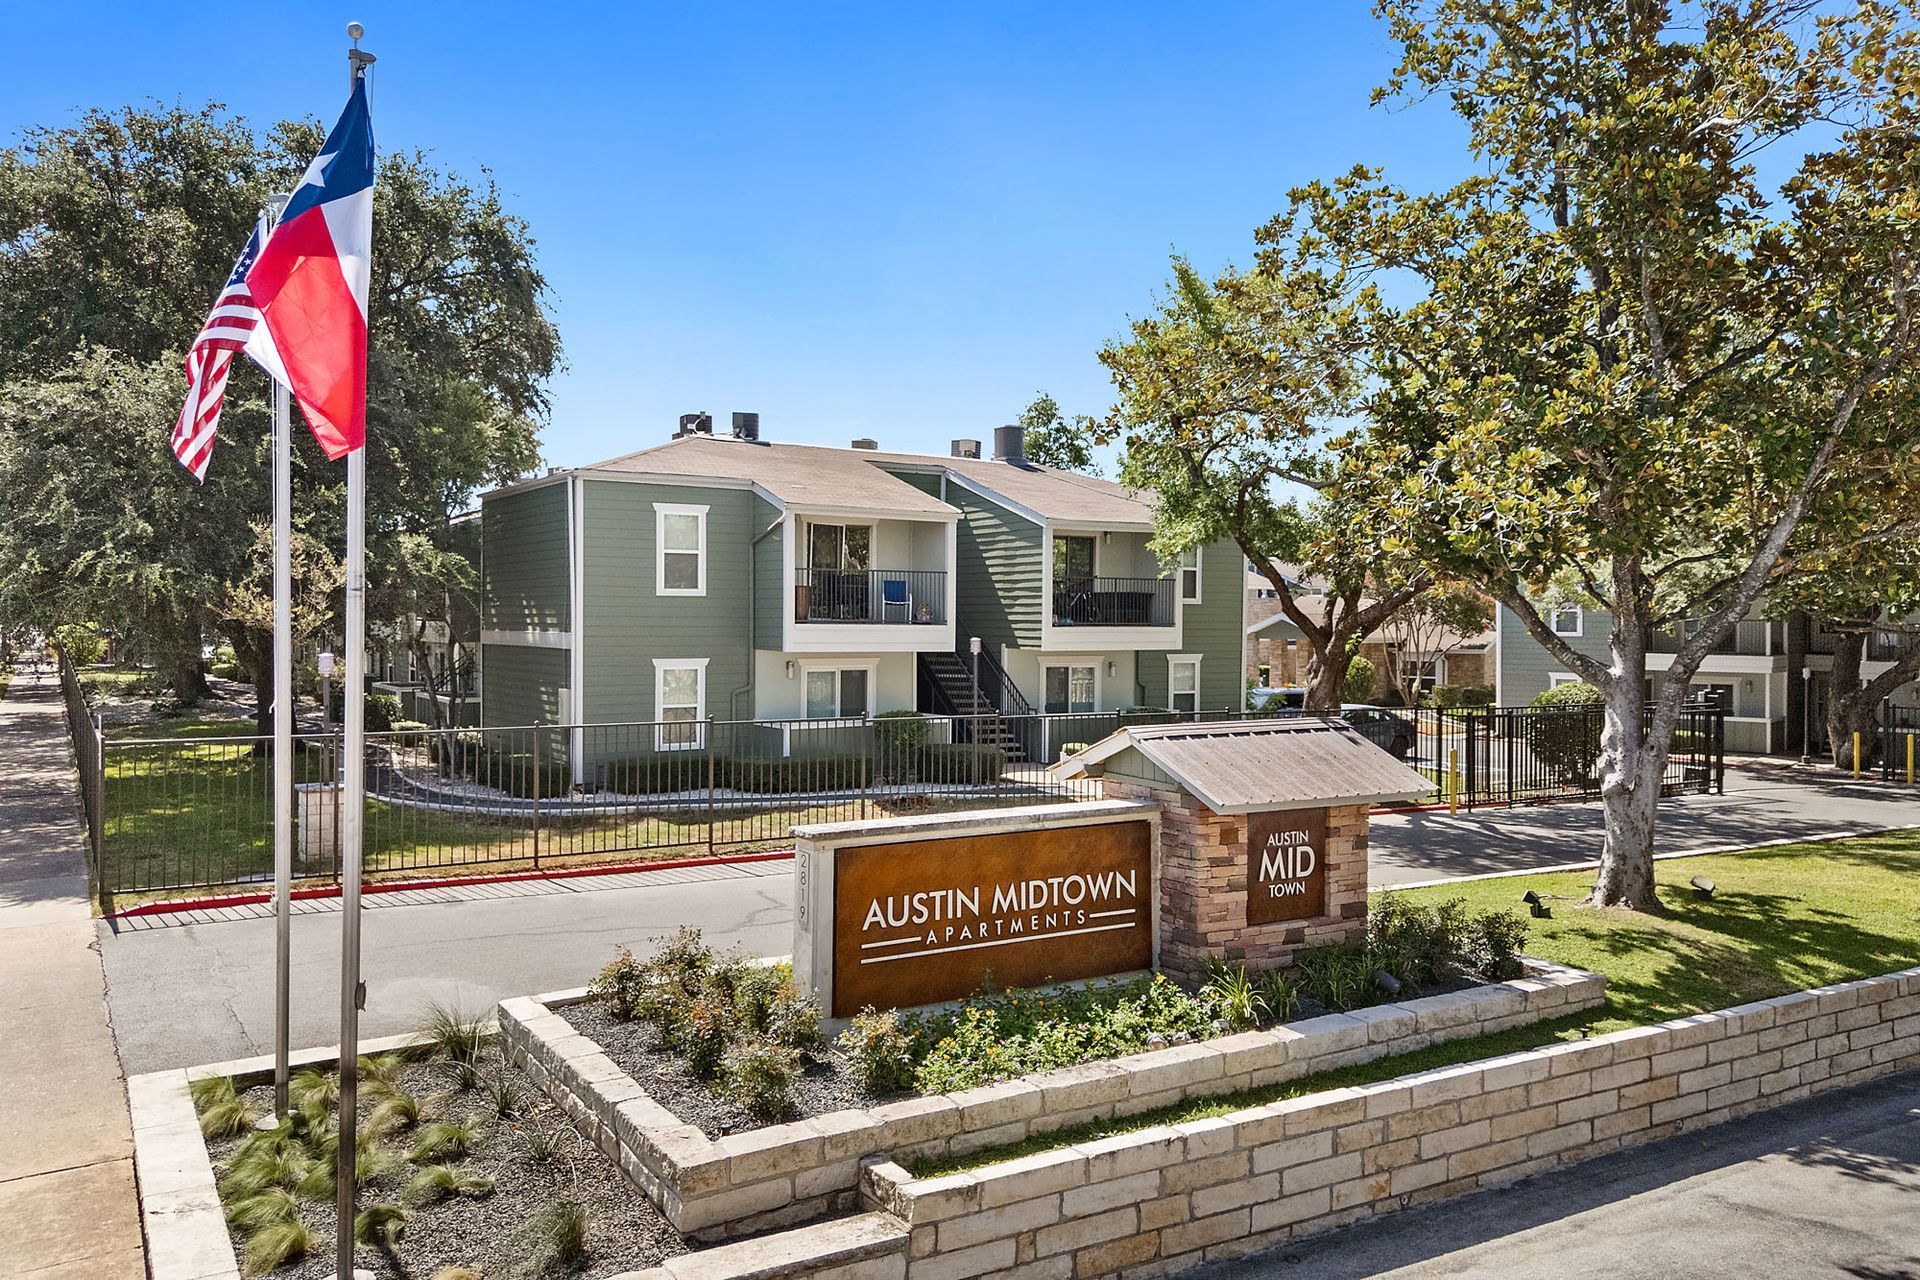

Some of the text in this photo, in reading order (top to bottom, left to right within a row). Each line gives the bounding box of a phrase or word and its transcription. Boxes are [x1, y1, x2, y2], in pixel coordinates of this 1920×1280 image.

[1267, 830, 1309, 847] AUSTIN
[1259, 846, 1316, 882] MID
[861, 869, 1137, 931] AUSTIN MIDTOWN
[1268, 881, 1306, 898] TOWN
[926, 909, 1086, 945] APARTMENTS
